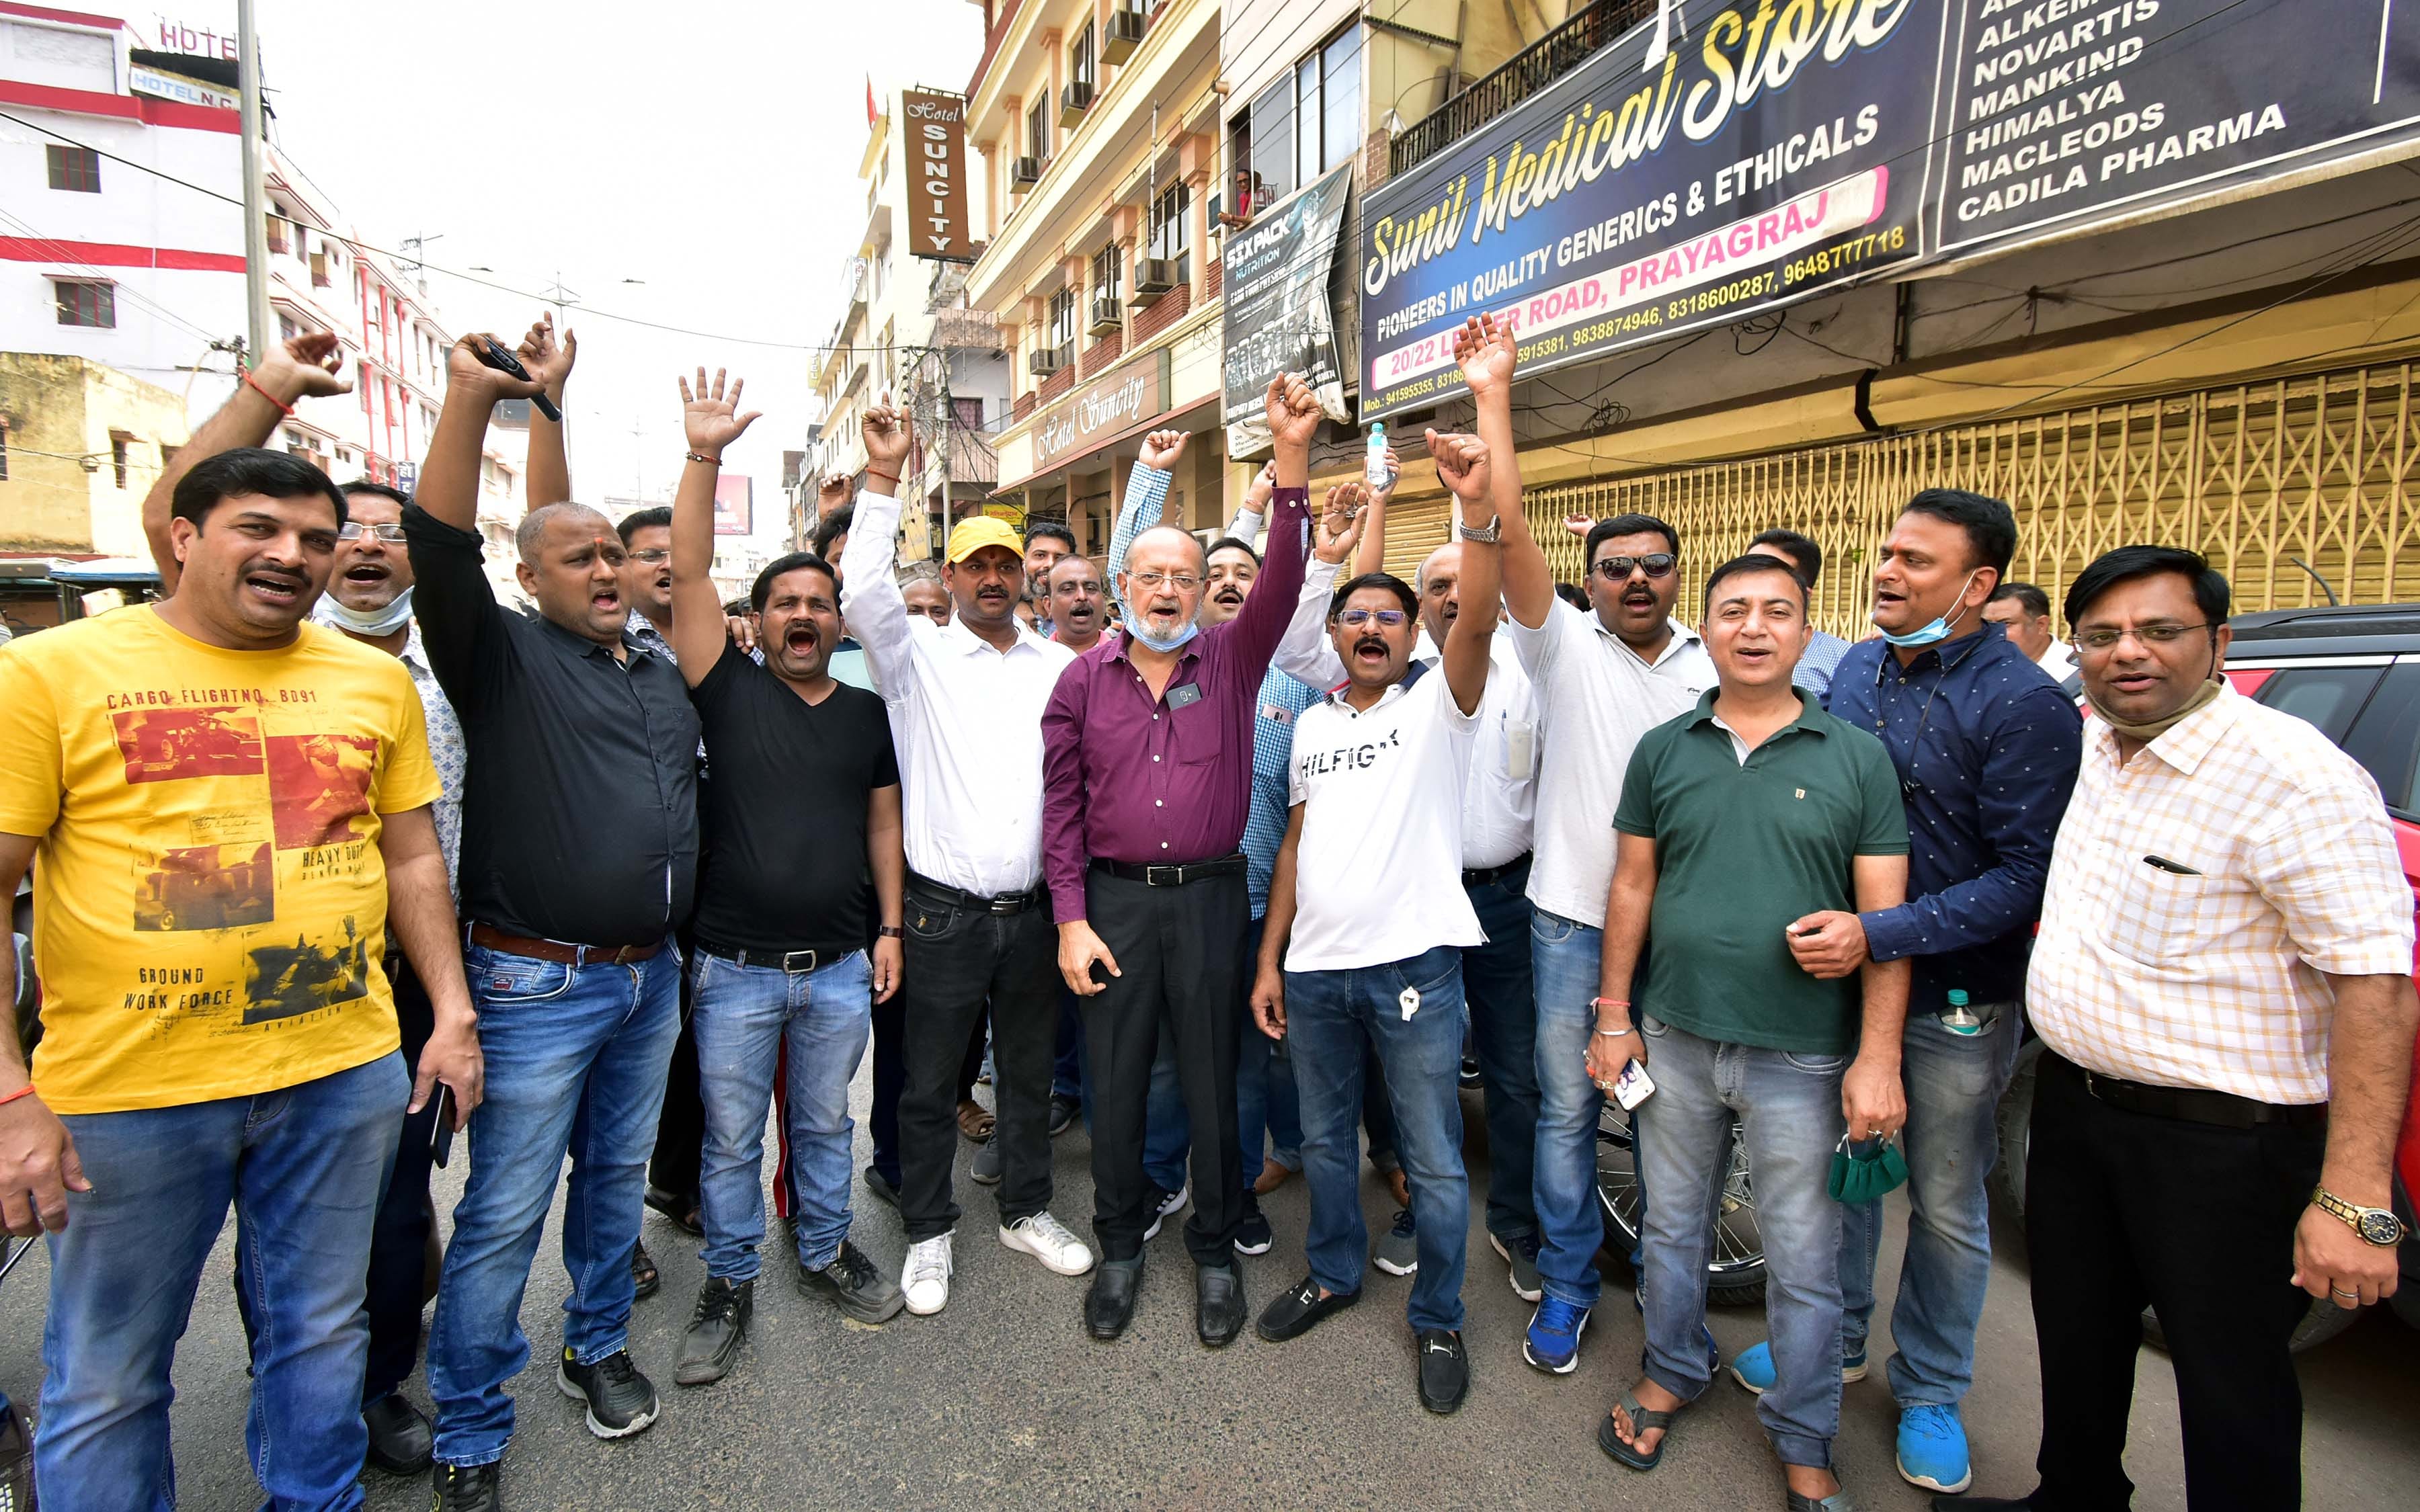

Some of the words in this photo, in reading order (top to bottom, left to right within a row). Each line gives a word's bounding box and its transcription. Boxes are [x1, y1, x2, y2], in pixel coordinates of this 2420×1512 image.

[160, 23, 238, 60] HOTE
[1969, 36, 2144, 121] MANKIND
[1973, 0, 2160, 87] NOVARTIS
[134, 73, 200, 102] HOTEL
[906, 101, 960, 122] Hotel
[1965, 79, 2126, 155] HIMALYA
[922, 124, 953, 251] SUNCITY
[1365, 175, 1470, 296] Sunil
[1471, 51, 1684, 243] Medical
[1682, 0, 1910, 141] Store
[1958, 165, 2088, 222] CADILA
[2100, 103, 2287, 182] PHARMA
[1961, 102, 2165, 190] MACLEODS
[1377, 290, 1447, 342] PIONEERS
[1450, 282, 1468, 311] IN
[1471, 244, 1553, 302] QUALITY
[1556, 192, 1678, 267] GENERICS
[1685, 180, 1706, 217] &
[1715, 103, 1880, 206] ETHICALS
[1363, 396, 1384, 413] Mob.:
[1385, 378, 1436, 407] 9415955355,
[1572, 306, 1663, 347] 9838874946,
[1668, 271, 1779, 320] 8318600287,
[1784, 226, 1905, 285] 9648777718
[1391, 339, 1435, 376] 20/22
[1441, 307, 1521, 357] LEER
[1528, 278, 1608, 327] ROAD,
[1619, 191, 1829, 297] PRAYAGRAJ
[1037, 405, 1076, 461] Hotel
[1079, 376, 1144, 435] Suncity
[106, 690, 168, 710] CARGO
[1302, 728, 1399, 778] HILFIG
[302, 847, 340, 868] HEAVY
[346, 843, 365, 861] DUTY
[124, 993, 167, 1010] WORK
[179, 989, 232, 1009] FORCE
[139, 968, 204, 984] GROUND
